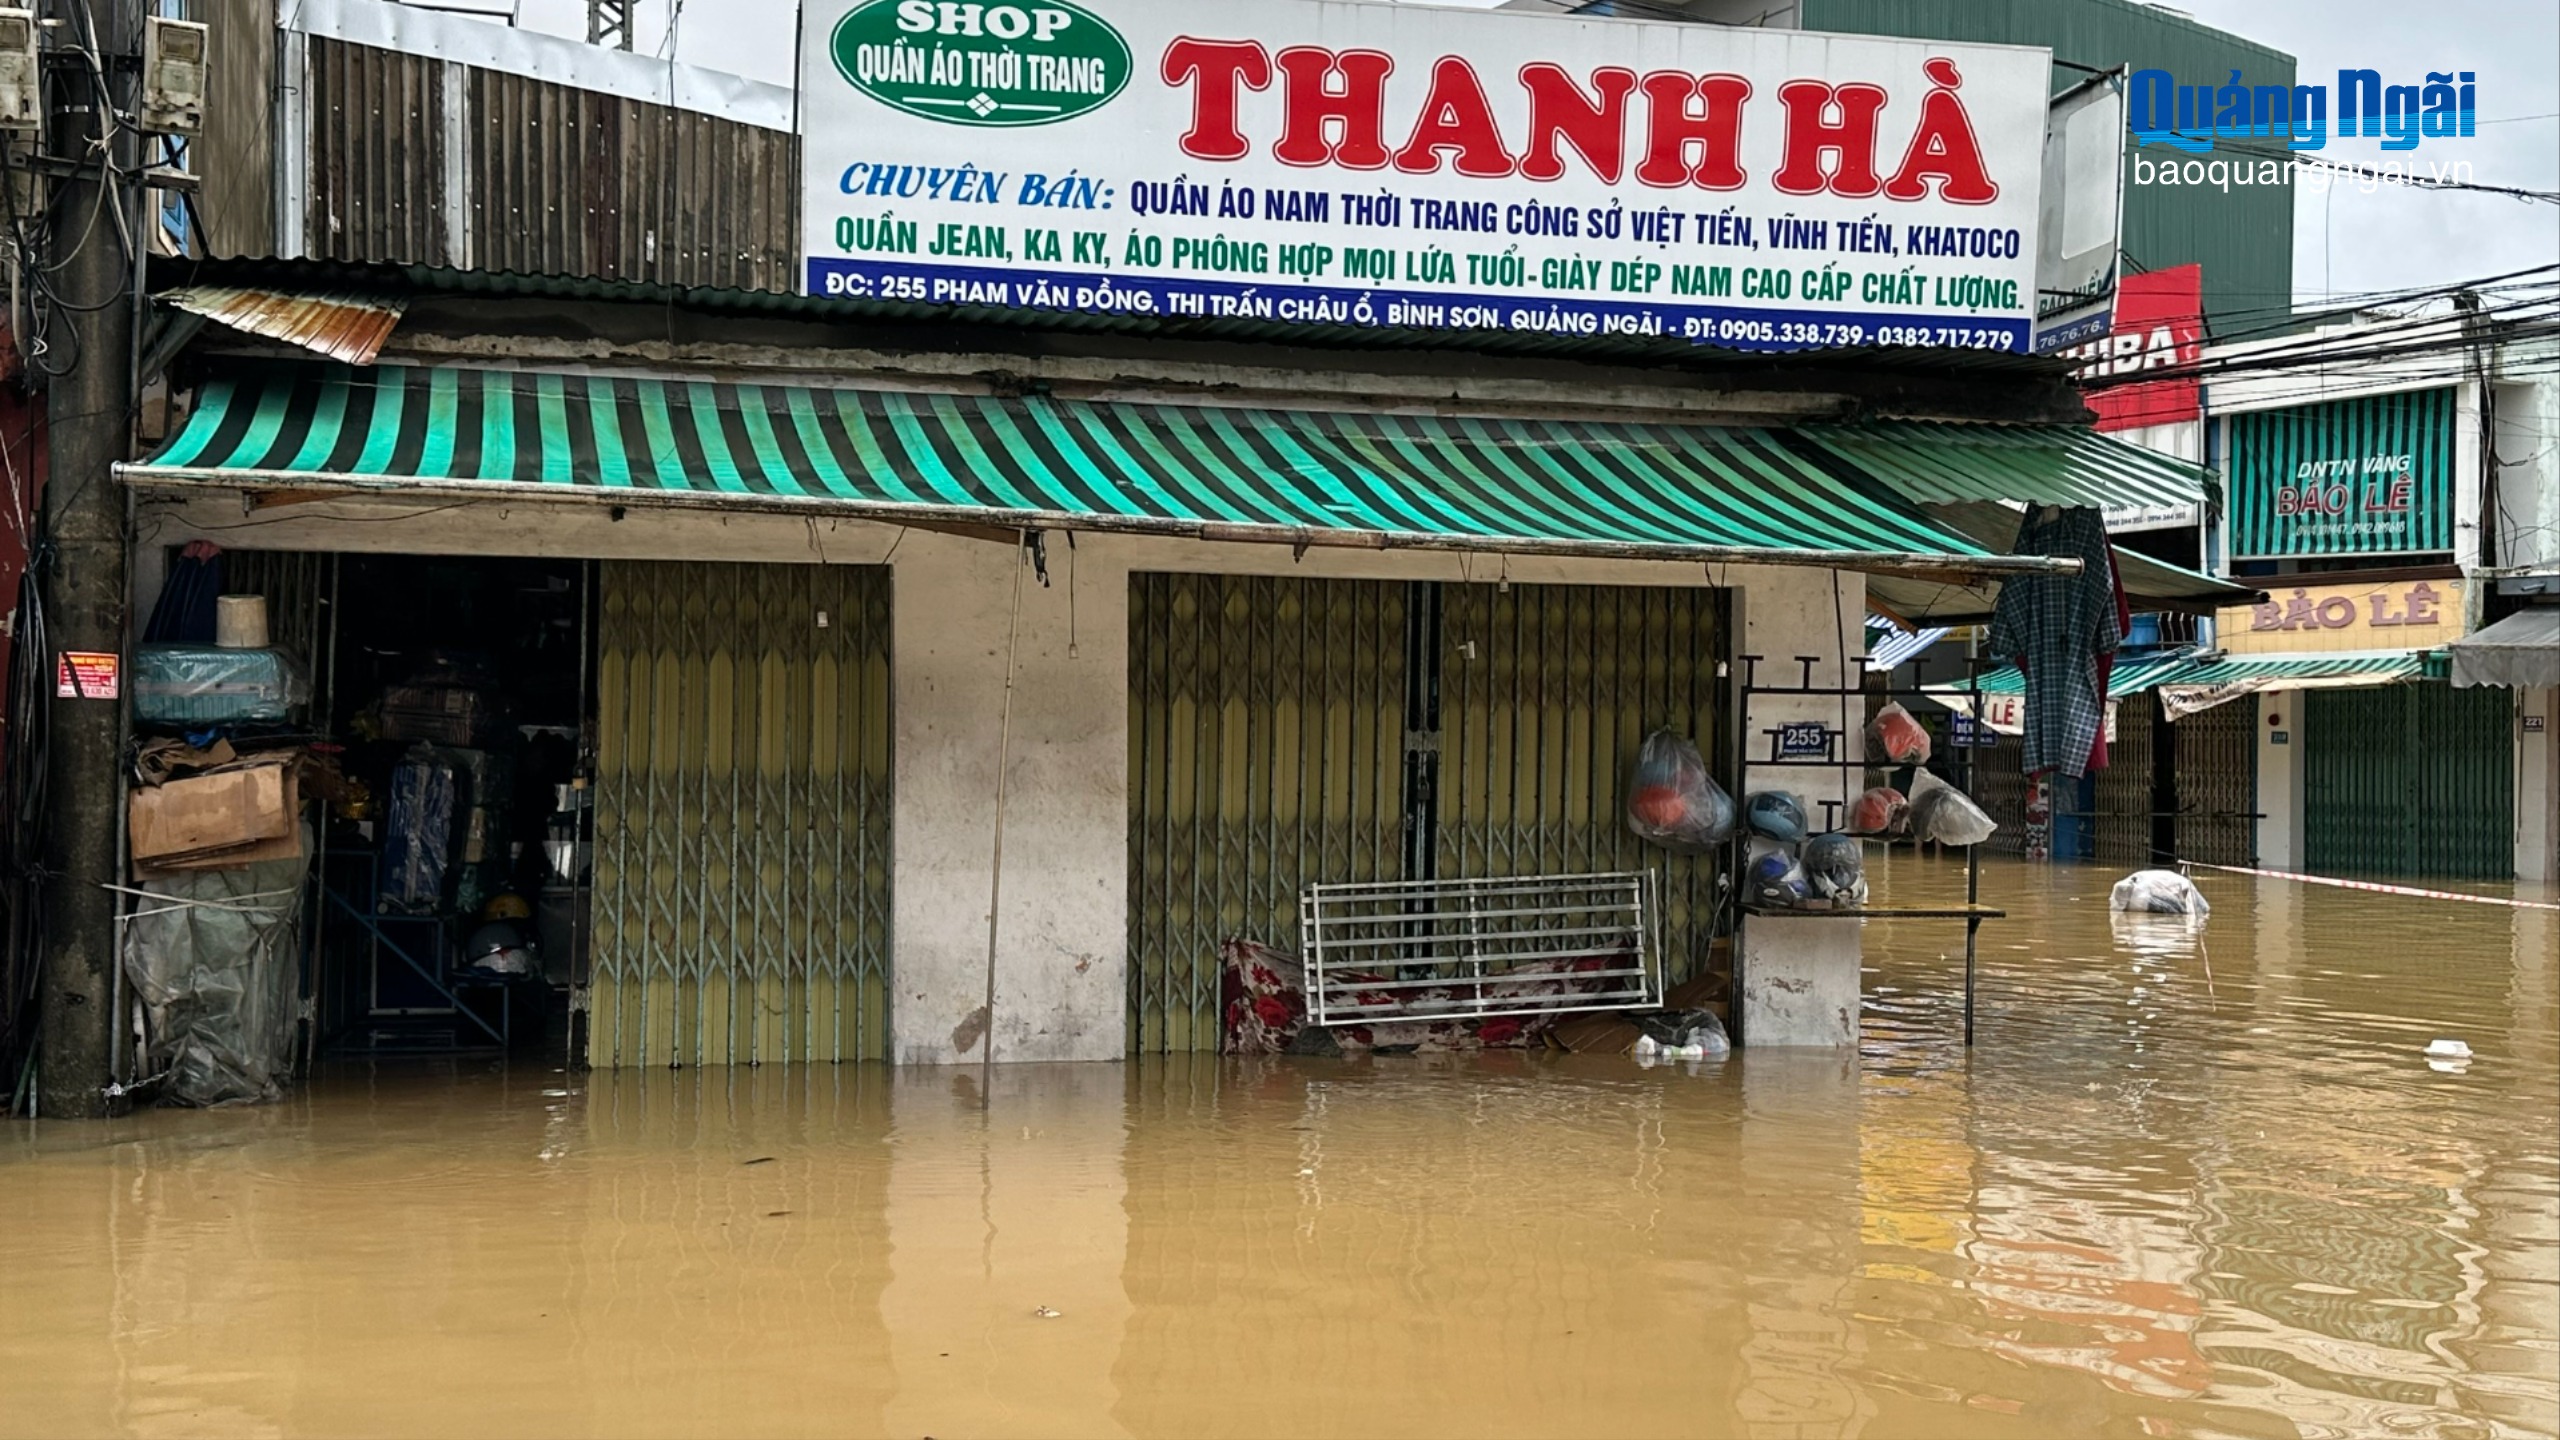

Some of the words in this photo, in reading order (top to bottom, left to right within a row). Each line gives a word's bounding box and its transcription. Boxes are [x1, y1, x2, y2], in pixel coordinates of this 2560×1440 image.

[896, 0, 1072, 41] SHOP
[857, 36, 925, 84] QUẦN
[930, 41, 963, 87] ÁO
[968, 44, 1021, 90] THỜI
[1027, 54, 1105, 94] TRANG
[1161, 35, 1752, 190] THANH
[1772, 57, 2000, 205] HÀ
[839, 161, 1008, 204] CHUYÊN
[1018, 169, 1115, 210] BÁN:
[1130, 173, 1209, 216] QUẦN
[1218, 180, 1254, 219] ÁO
[1265, 188, 1329, 223] NAM
[1341, 187, 1400, 227] THỜI
[1410, 198, 1498, 233] TRANG
[1506, 198, 1578, 237] CÔNG
[1587, 197, 1623, 239] SỞ
[1631, 206, 1686, 248] VIỆT
[1695, 206, 1759, 251] TIẾN,
[1768, 214, 1828, 250] VĨNH
[1837, 213, 1899, 258] TIẾN,
[1907, 225, 2020, 259] KHATOCO
[836, 211, 917, 253] QUẦN
[929, 223, 1013, 263] JEAN,
[1024, 229, 1062, 262] KA
[1073, 231, 1110, 268] KY,
[1124, 228, 1161, 268] ÁO
[1172, 234, 1268, 273] PHÔNG
[1279, 242, 1333, 282] HỢP
[1344, 247, 1395, 286] MỌI
[1406, 244, 1456, 283] LỨA
[1610, 256, 1661, 294] DÉP
[1671, 264, 1731, 297] NAM
[1741, 266, 1791, 299] CAO
[1801, 261, 1852, 301] CẤP
[1862, 266, 1927, 305] CHẤT
[1935, 274, 2024, 313] LƯỢNG.
[826, 272, 873, 296] ĐC:
[881, 276, 927, 299] 255
[1016, 279, 1069, 306] VĂN
[1210, 288, 1271, 318] TRẤN
[1278, 295, 1348, 321] CHÂU
[1354, 291, 1378, 325] Ổ,
[1388, 299, 1443, 326] BÌNH
[1511, 305, 1597, 332] QUẢNG
[1604, 311, 1661, 336] NGÃI
[1684, 317, 1717, 338] ĐT:
[2297, 459, 2356, 478] DNTN
[2277, 478, 2349, 516] BẢO
[2365, 472, 2412, 512] LÊ
[2251, 589, 2357, 631] BẢO
[2369, 583, 2439, 626] LÊ
[1992, 698, 2015, 725] LÊ
[1786, 729, 1820, 746] 255
